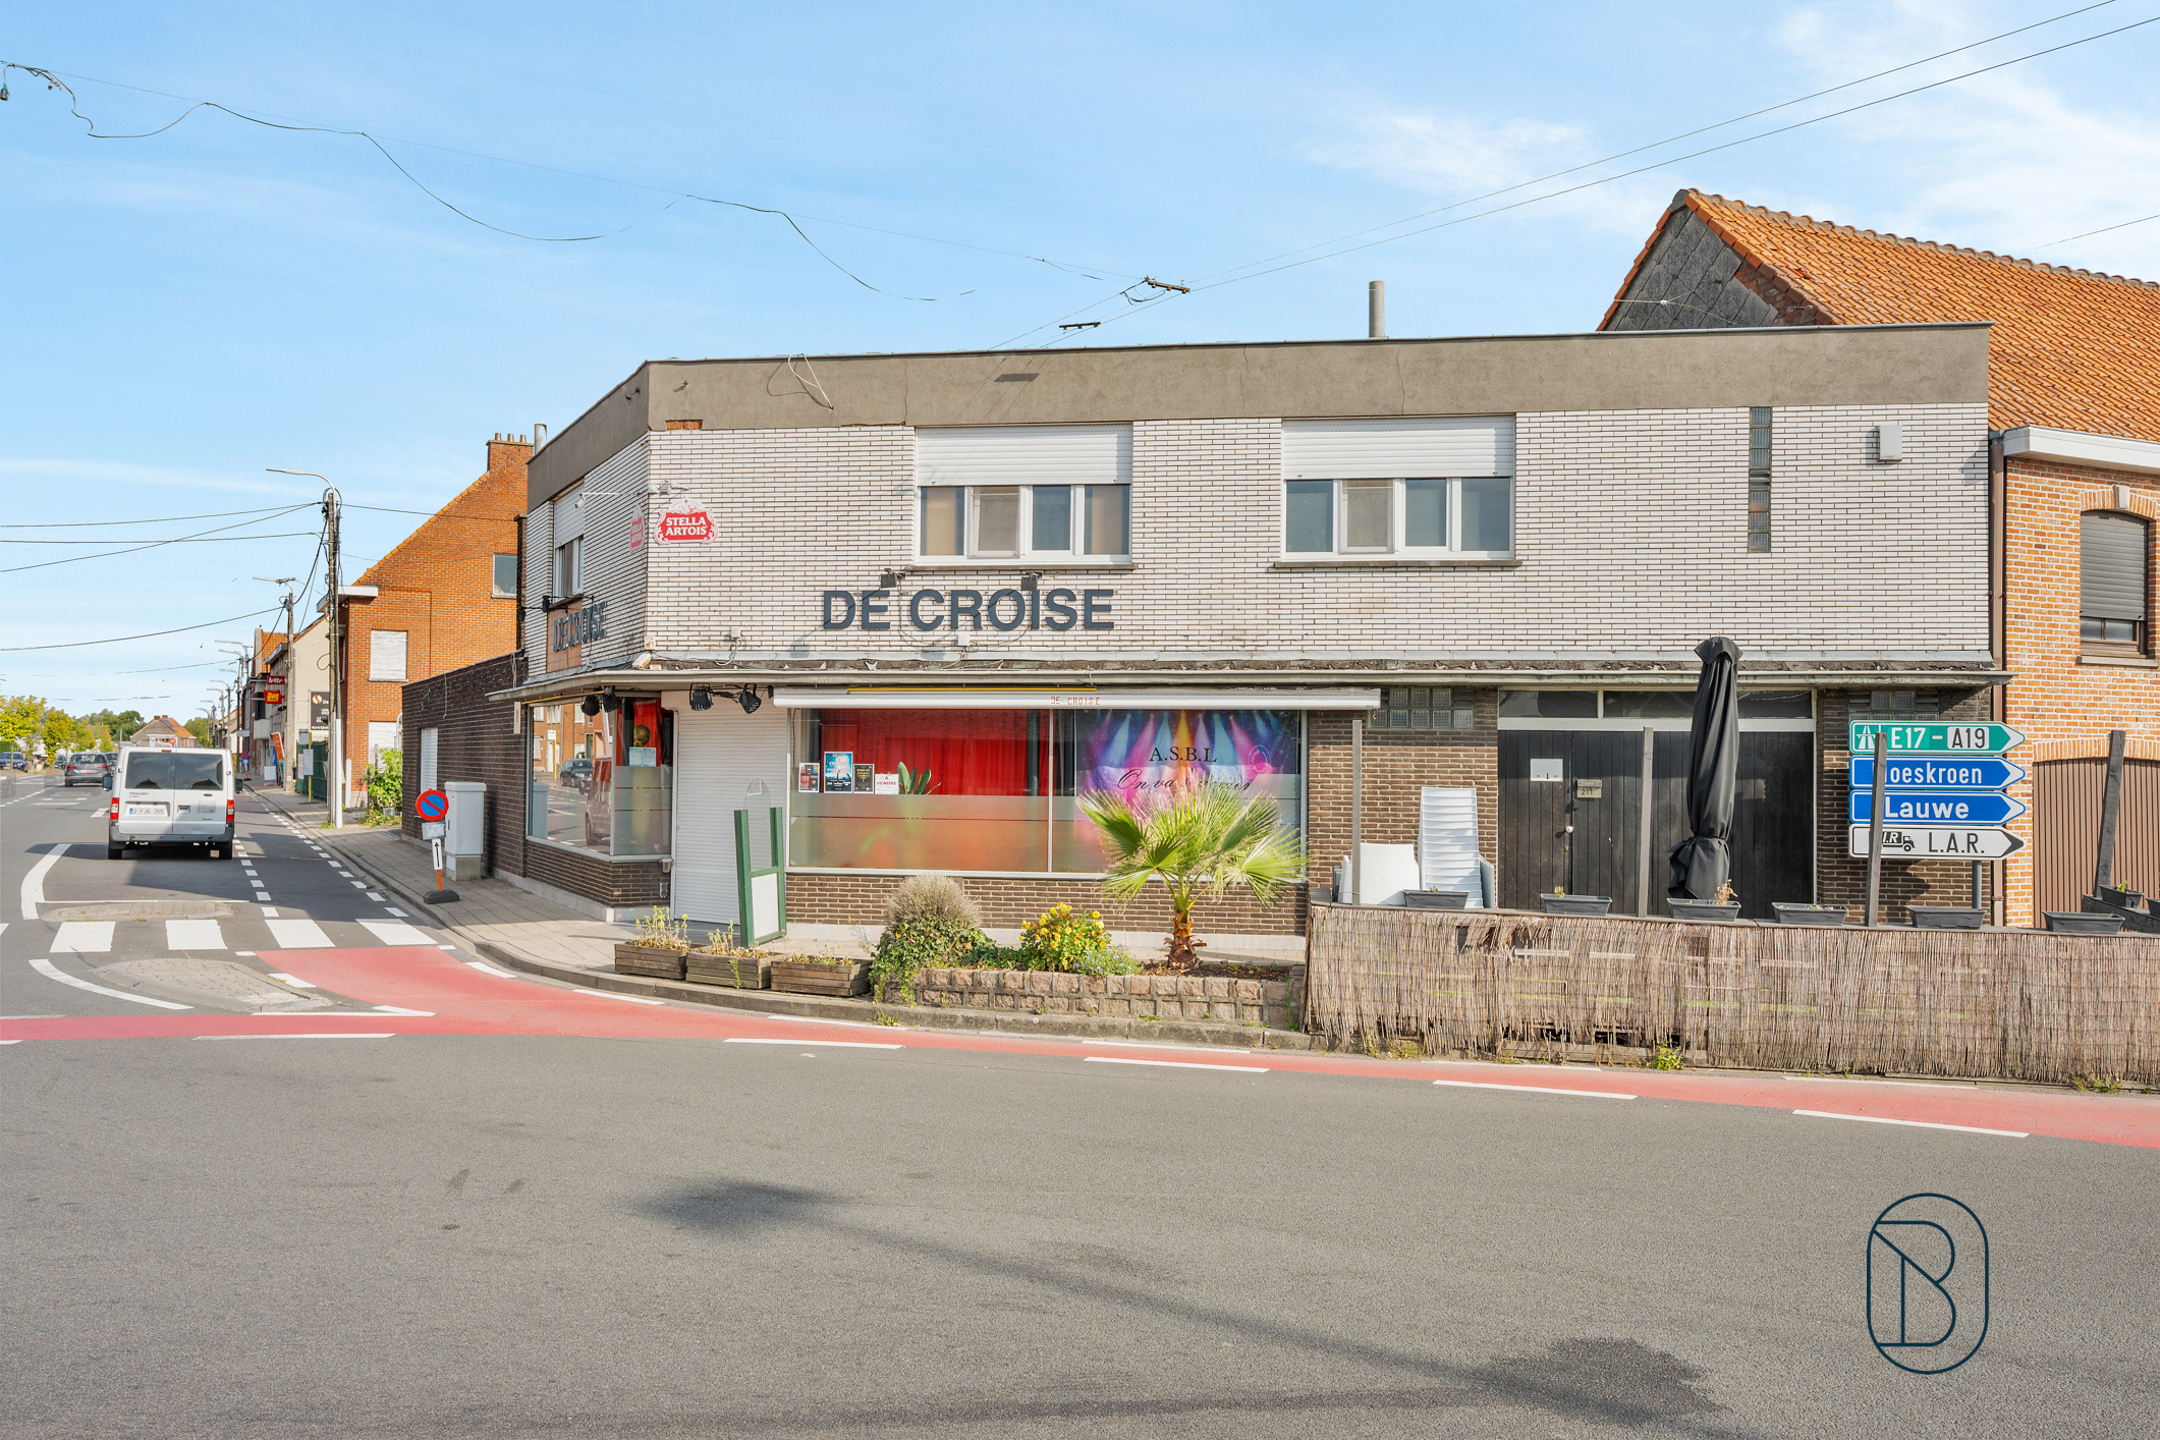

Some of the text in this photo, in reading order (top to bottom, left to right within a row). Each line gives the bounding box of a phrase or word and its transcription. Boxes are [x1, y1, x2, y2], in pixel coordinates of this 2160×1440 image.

[665, 526, 707, 536] ARTOIS
[666, 517, 706, 526] STELLA
[823, 588, 1114, 631] DE CROISE
[553, 601, 607, 652] DE CROISE
[1067, 697, 1100, 705] CROISE
[1891, 727, 1926, 748] E17
[1952, 728, 1985, 748] A19
[1149, 746, 1217, 762] A.S.B.L
[1117, 768, 1149, 790] On
[1153, 779, 1176, 788] va
[1872, 762, 1982, 784] oeskroen
[1580, 788, 1593, 796] 211
[1884, 796, 1969, 819] Lauwe
[1928, 832, 1985, 853] L.A.R.
